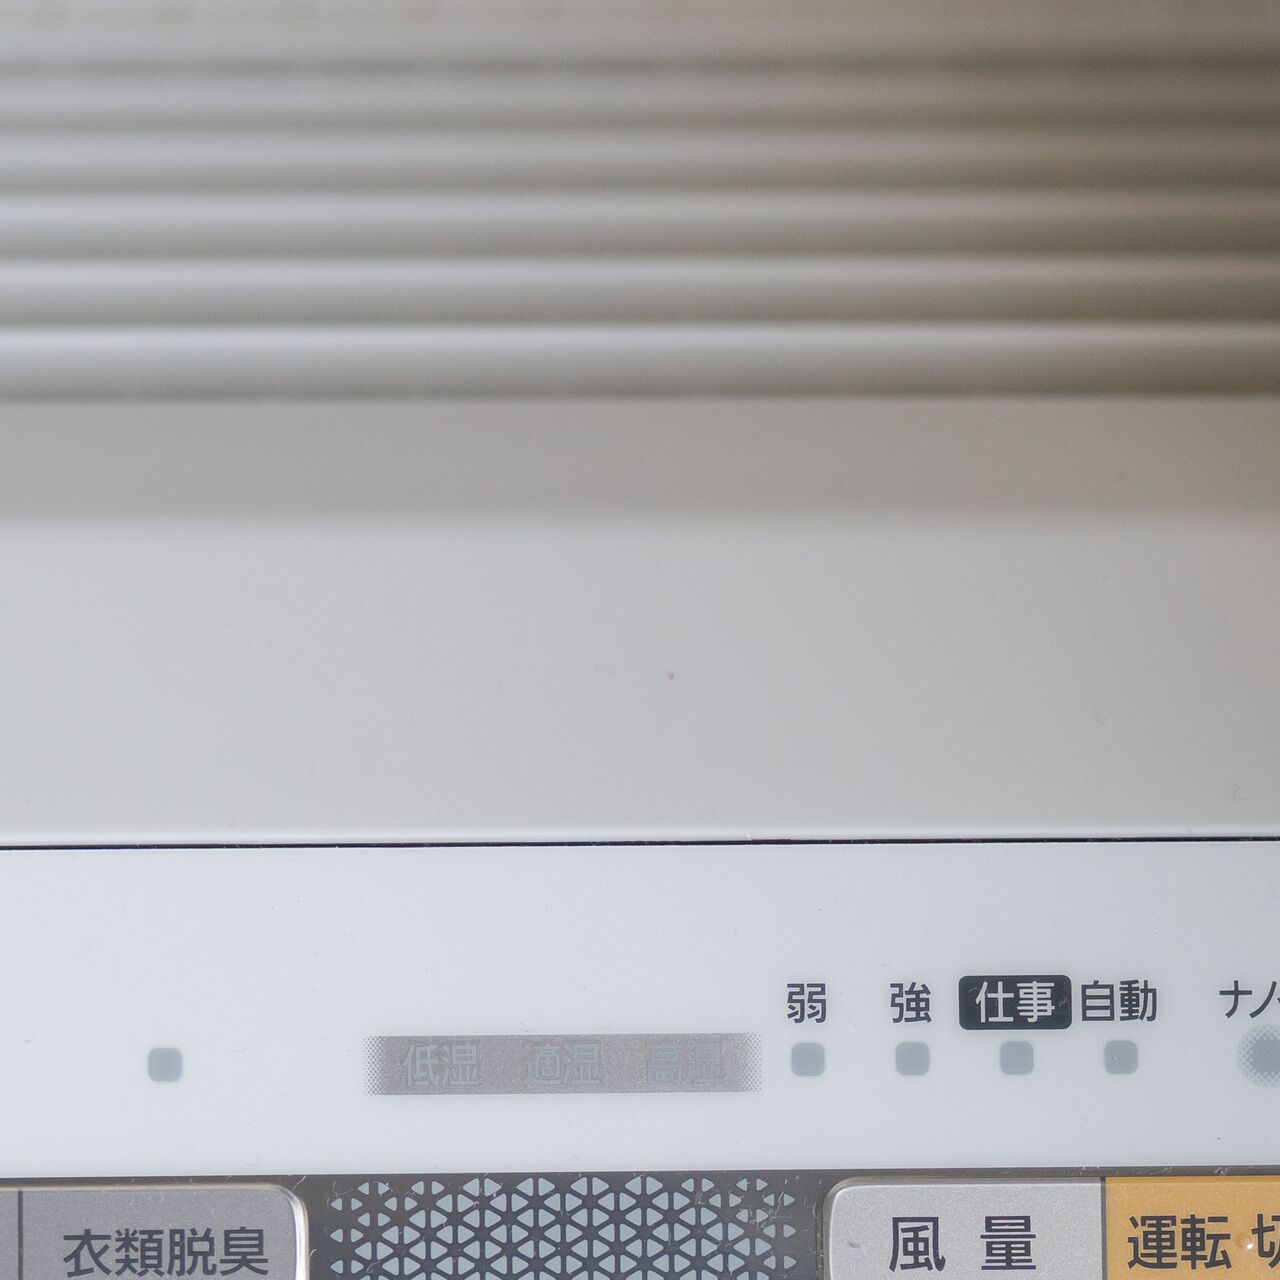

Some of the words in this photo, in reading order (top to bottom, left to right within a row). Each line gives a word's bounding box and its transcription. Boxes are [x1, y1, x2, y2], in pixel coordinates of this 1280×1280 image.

[786, 983, 827, 1024] 弱
[889, 981, 932, 1024] 強
[975, 980, 1056, 1023] 仕事
[1080, 979, 1157, 1022] 自動
[63, 1226, 269, 1278] 衣類脱臭
